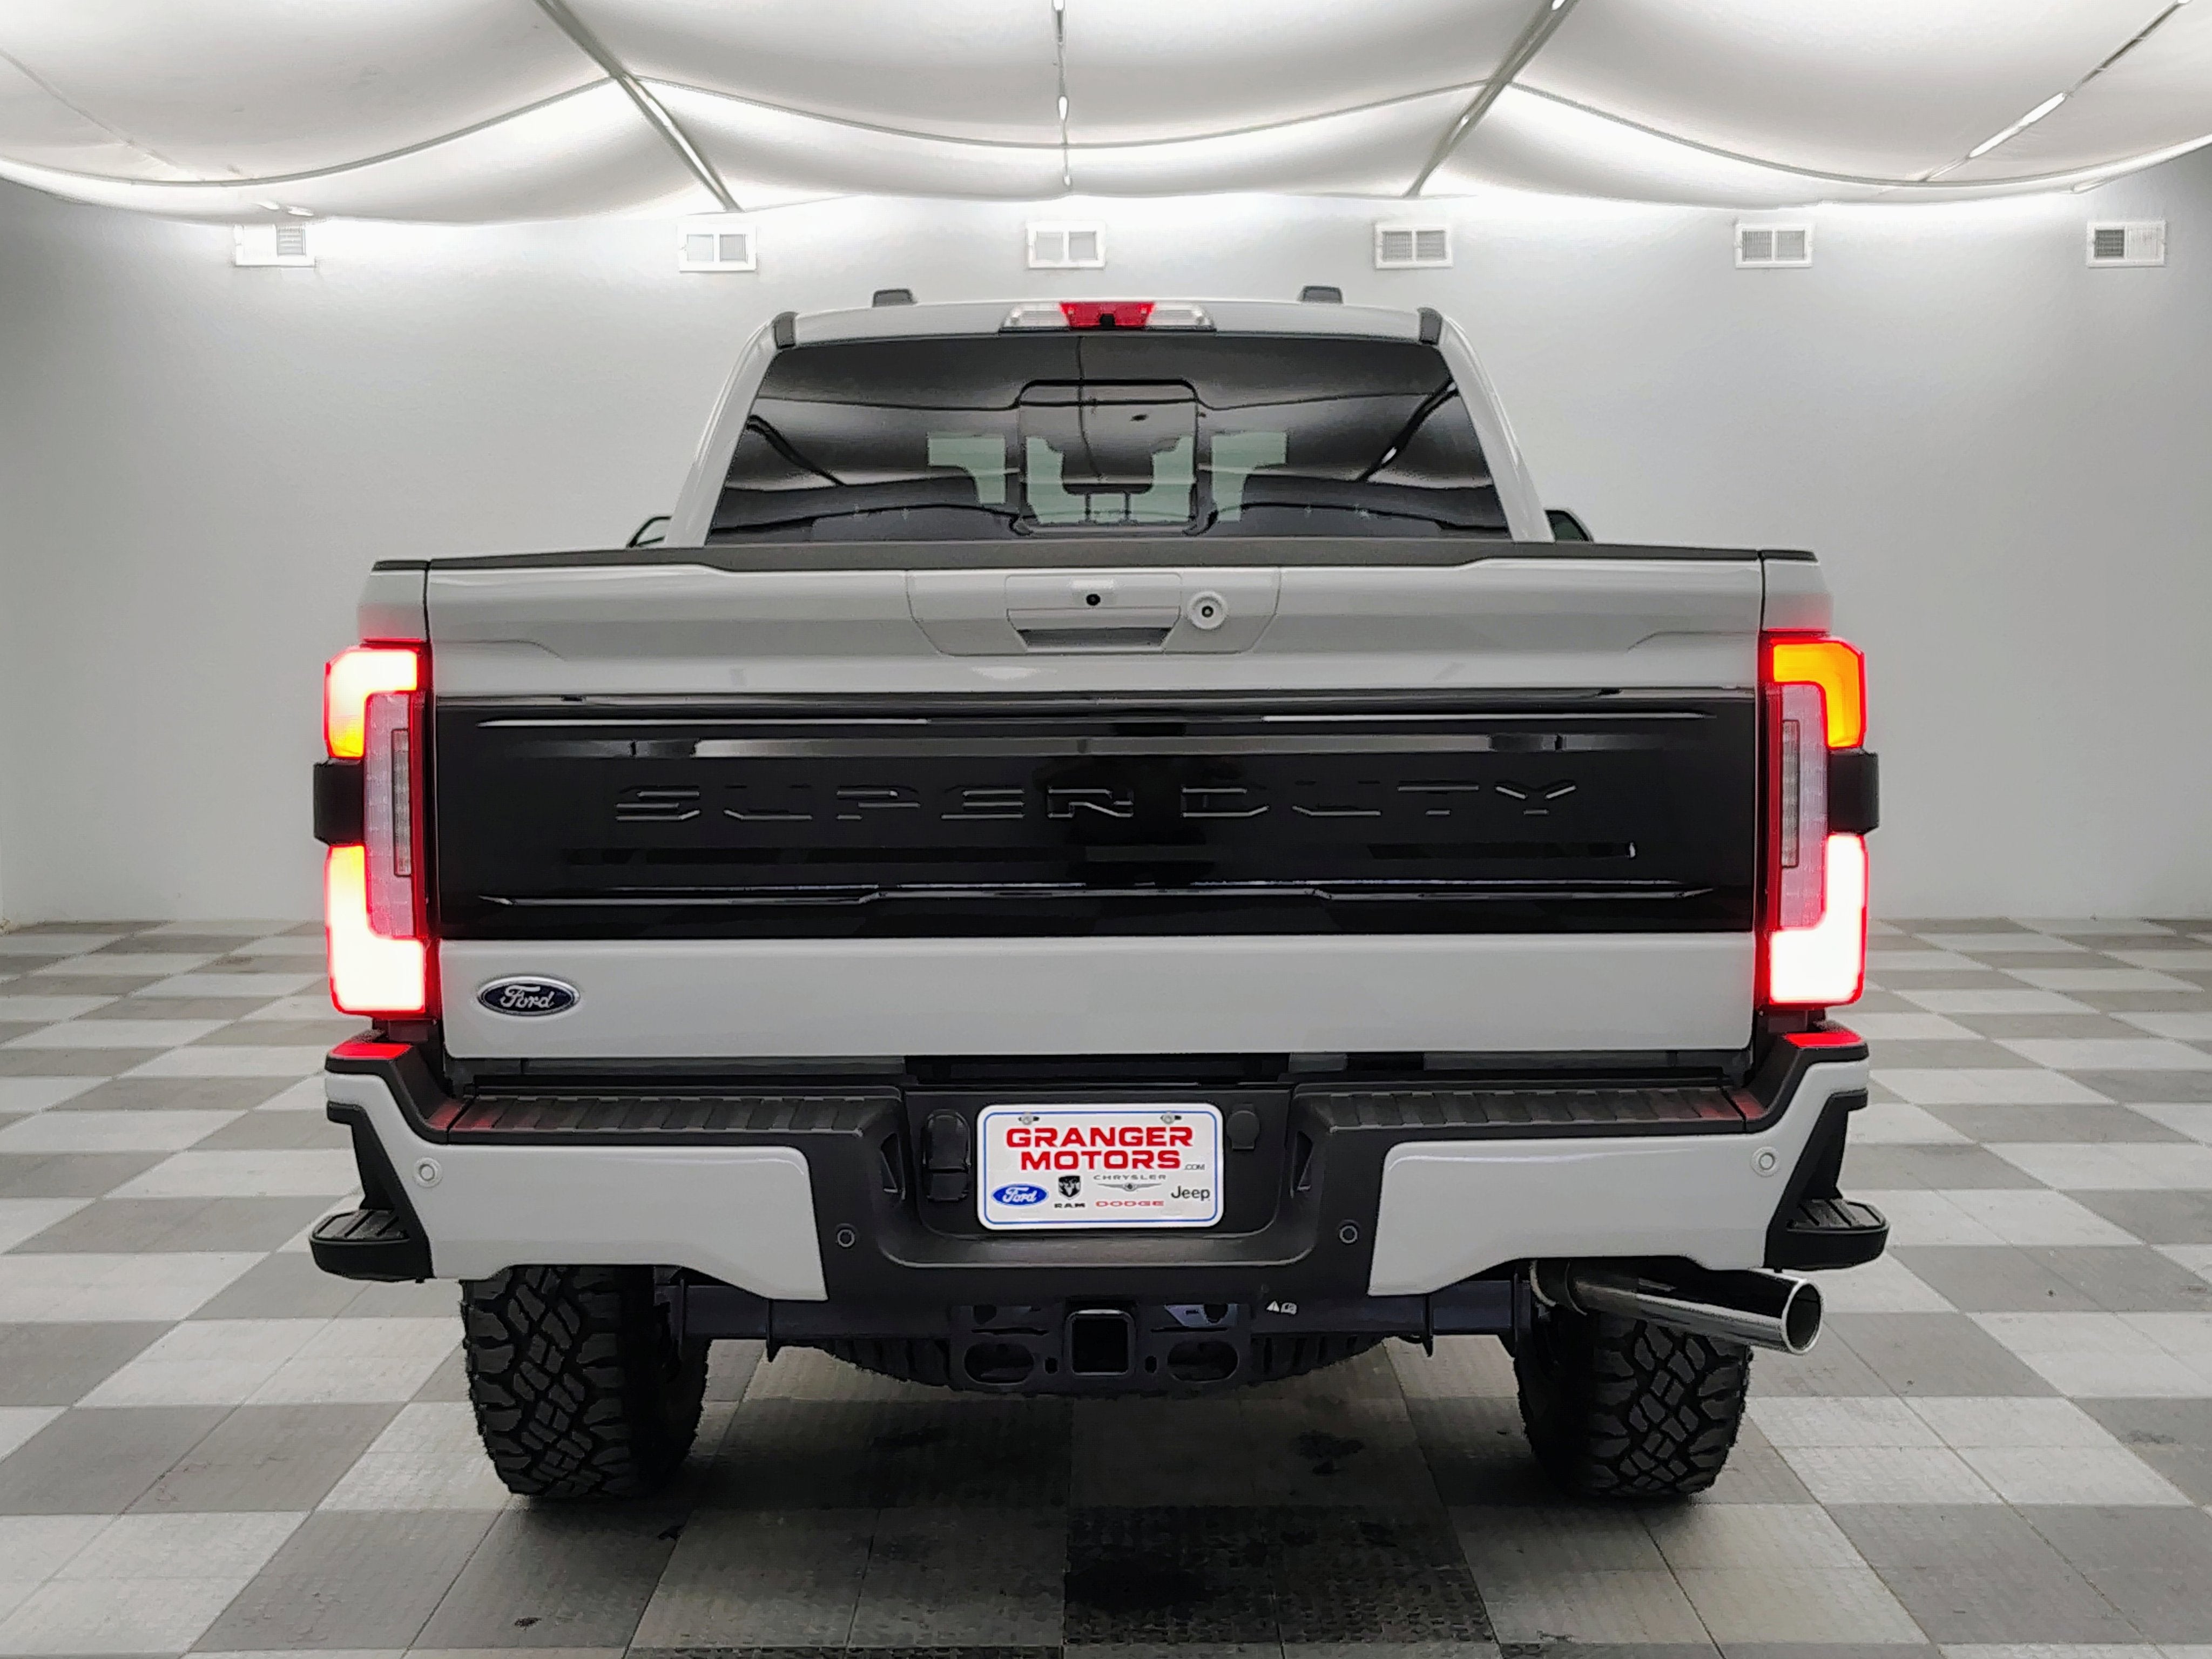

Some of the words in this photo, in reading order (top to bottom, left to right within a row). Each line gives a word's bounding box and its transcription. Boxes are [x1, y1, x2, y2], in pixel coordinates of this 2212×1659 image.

[615, 784, 1135, 821] SUPER
[1180, 781, 1578, 819] DUTY
[500, 984, 555, 1008] Ford
[1006, 1127, 1193, 1147] GRANGER
[1021, 1150, 1181, 1170] MOTORS
[1003, 1186, 1037, 1203] Ford
[1170, 1185, 1211, 1201] Jeep
